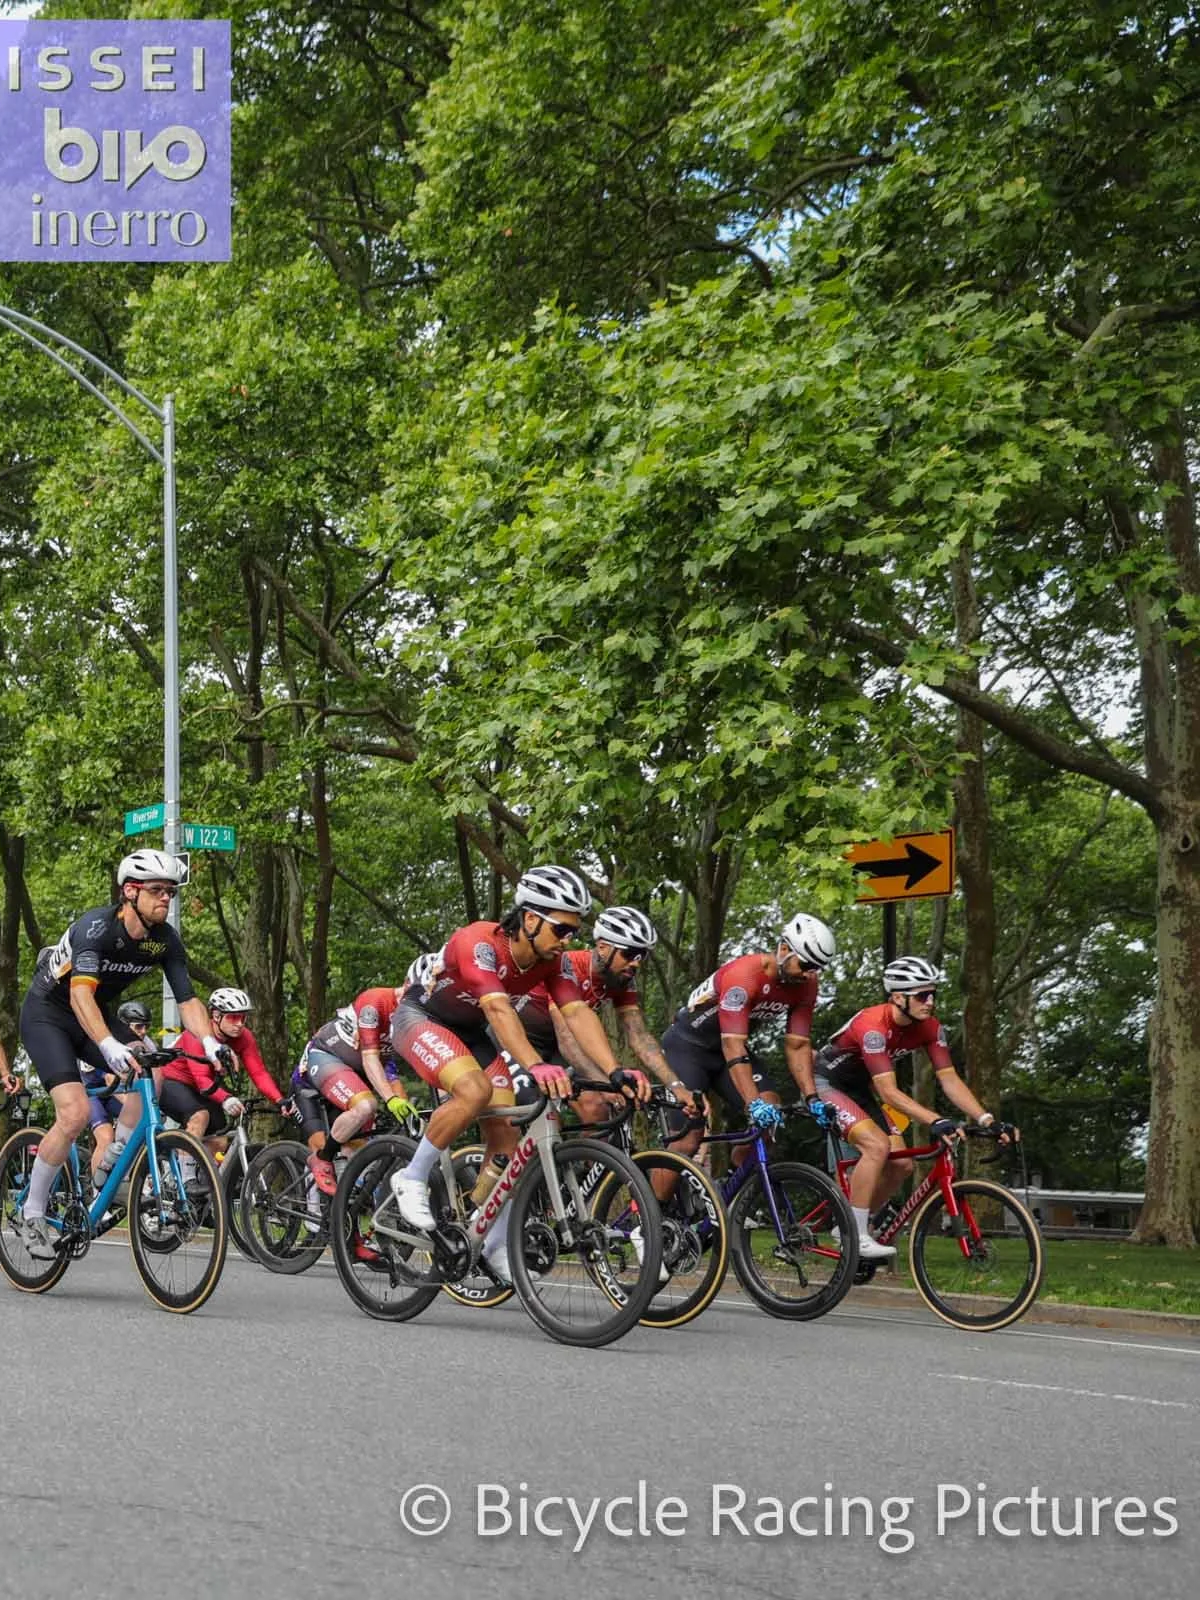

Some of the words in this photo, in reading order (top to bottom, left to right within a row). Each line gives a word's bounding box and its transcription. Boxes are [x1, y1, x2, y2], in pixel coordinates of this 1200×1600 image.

[132, 807, 159, 825] Riverside
[185, 827, 195, 845] W
[200, 829, 219, 847] 122
[418, 1030, 456, 1061] MAJOR
[410, 1041, 440, 1072] TAYLOR
[450, 1283, 489, 1300] rova
